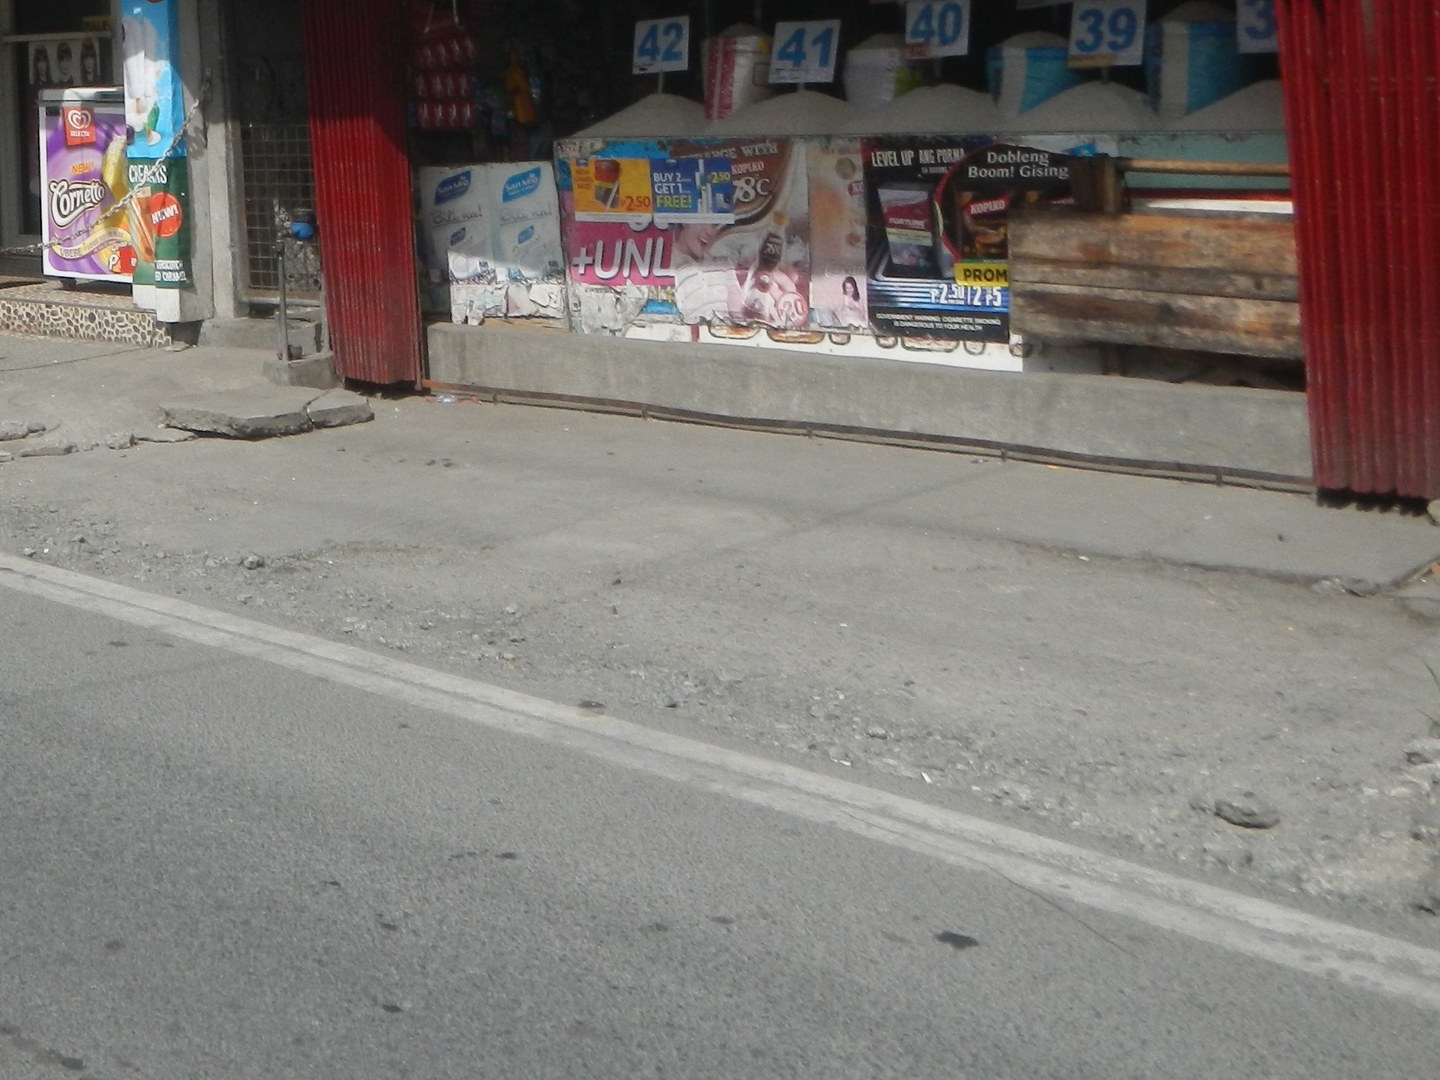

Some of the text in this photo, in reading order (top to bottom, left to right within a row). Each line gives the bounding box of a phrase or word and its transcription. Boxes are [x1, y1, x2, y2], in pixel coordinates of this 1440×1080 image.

[910, 2, 961, 47] 40
[1075, 6, 1137, 54] 39
[637, 21, 684, 62] 42
[776, 28, 835, 69] 41
[871, 151, 898, 167] LEVEL
[900, 150, 914, 166] UP
[987, 150, 1050, 166] Dobleng
[653, 172, 675, 183] BUY
[968, 164, 1069, 180] Boom! Gising
[654, 183, 677, 195] GET
[48, 178, 106, 229] Cornetto
[655, 196, 692, 208] FREE!
[969, 199, 1006, 215] KOPIKO
[900, 321, 934, 329] DANGEROUS
